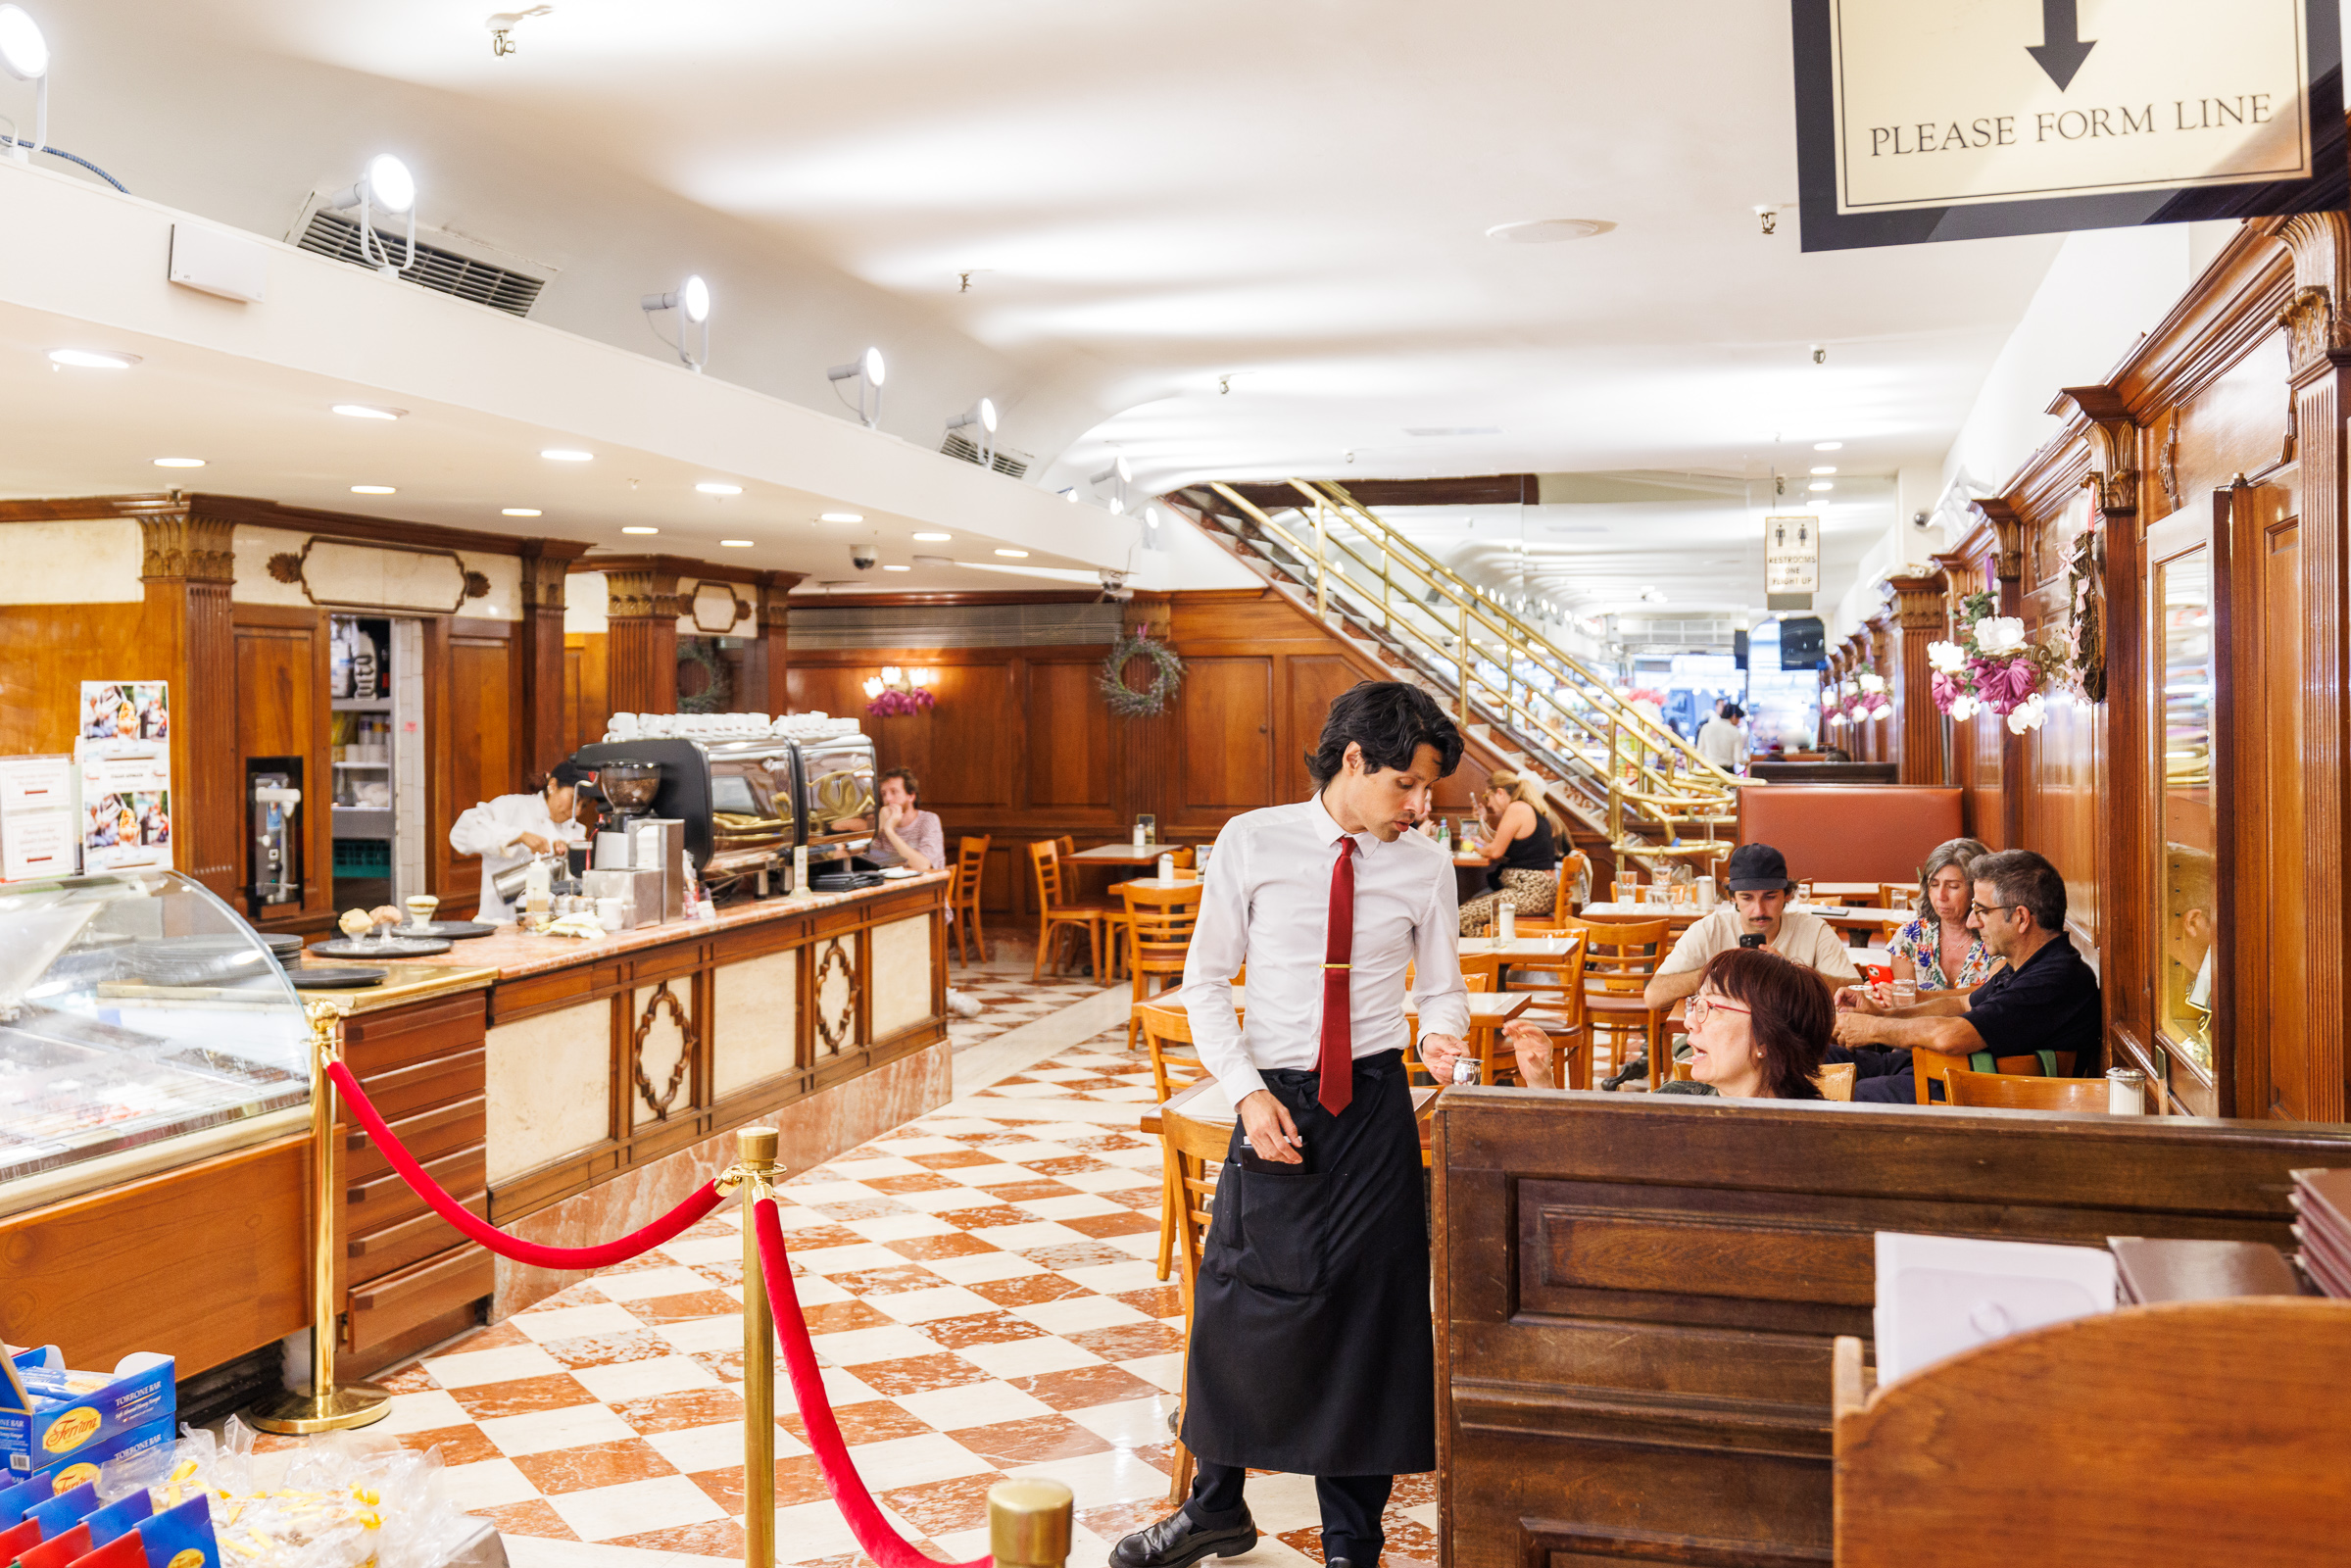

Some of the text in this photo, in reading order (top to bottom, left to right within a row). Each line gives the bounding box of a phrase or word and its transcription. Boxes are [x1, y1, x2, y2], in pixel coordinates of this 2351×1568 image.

[1868, 93, 2274, 157] PLEASE FORM LINE
[1769, 555, 1817, 564] RESTROOMS
[1785, 565, 1800, 574] ONE
[1773, 576, 1813, 585] FLIGHT UP
[115, 1385, 149, 1406] TORRONE
[149, 1380, 162, 1393] BAR
[114, 1433, 162, 1461] TORRONE BAR
